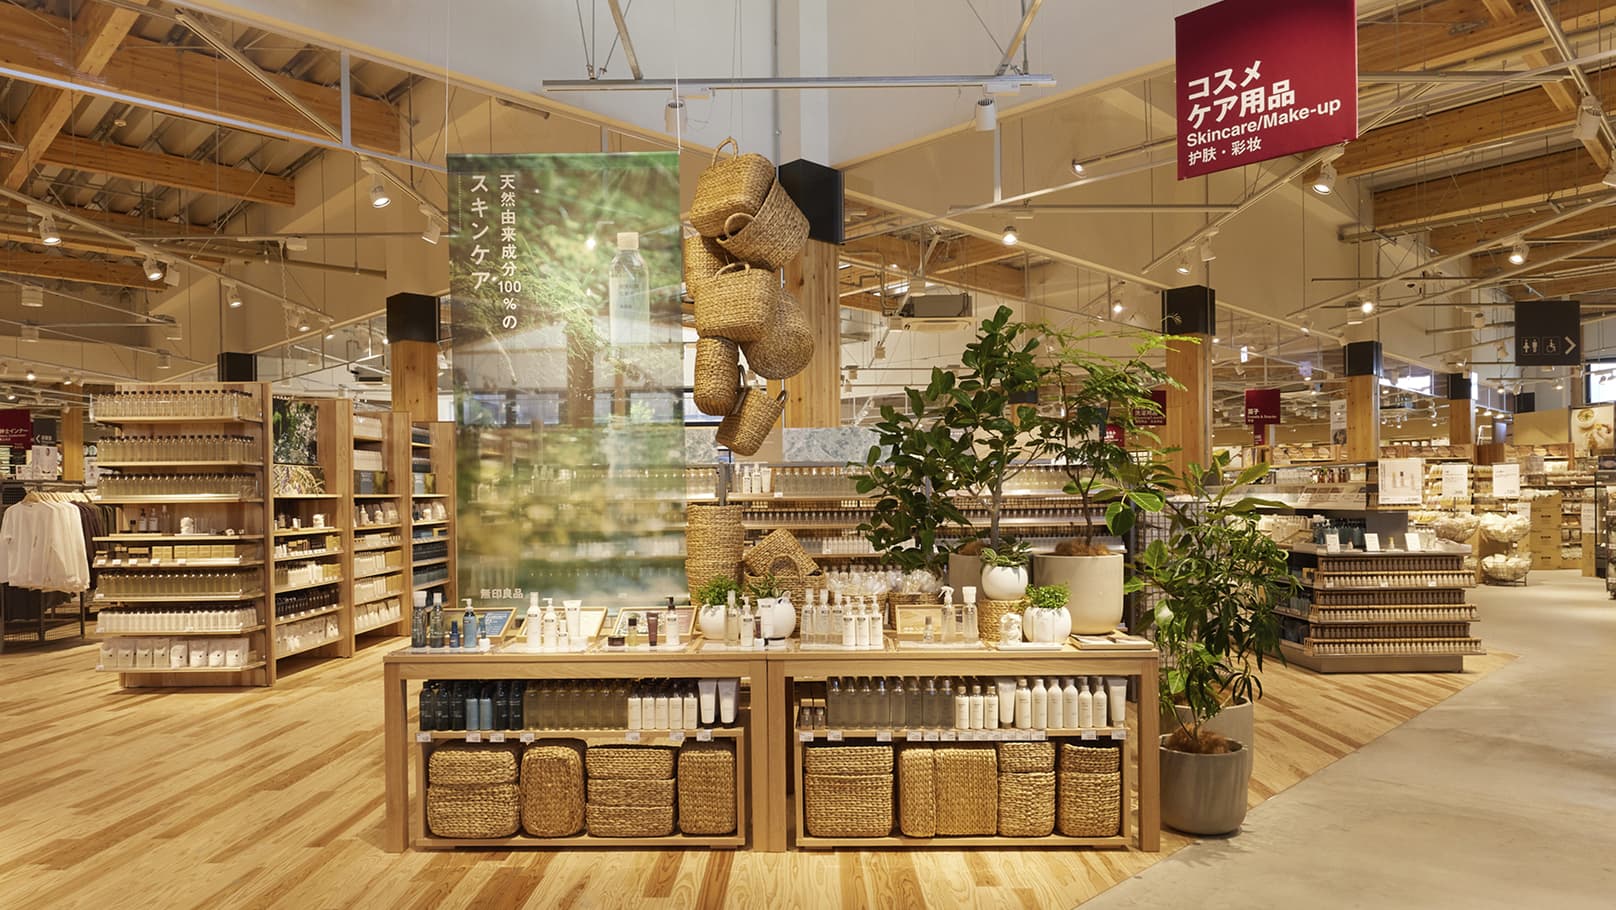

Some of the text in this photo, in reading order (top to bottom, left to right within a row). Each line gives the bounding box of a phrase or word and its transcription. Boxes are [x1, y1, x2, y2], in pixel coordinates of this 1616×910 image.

[1187, 79, 1296, 129] ケア用品
[1188, 60, 1262, 100] コスメ
[1186, 98, 1341, 147] Skincare/Make-up
[470, 175, 490, 289] スキンケア
[498, 174, 521, 329] 天然由来成分100%の
[480, 587, 524, 600] 無印良品
